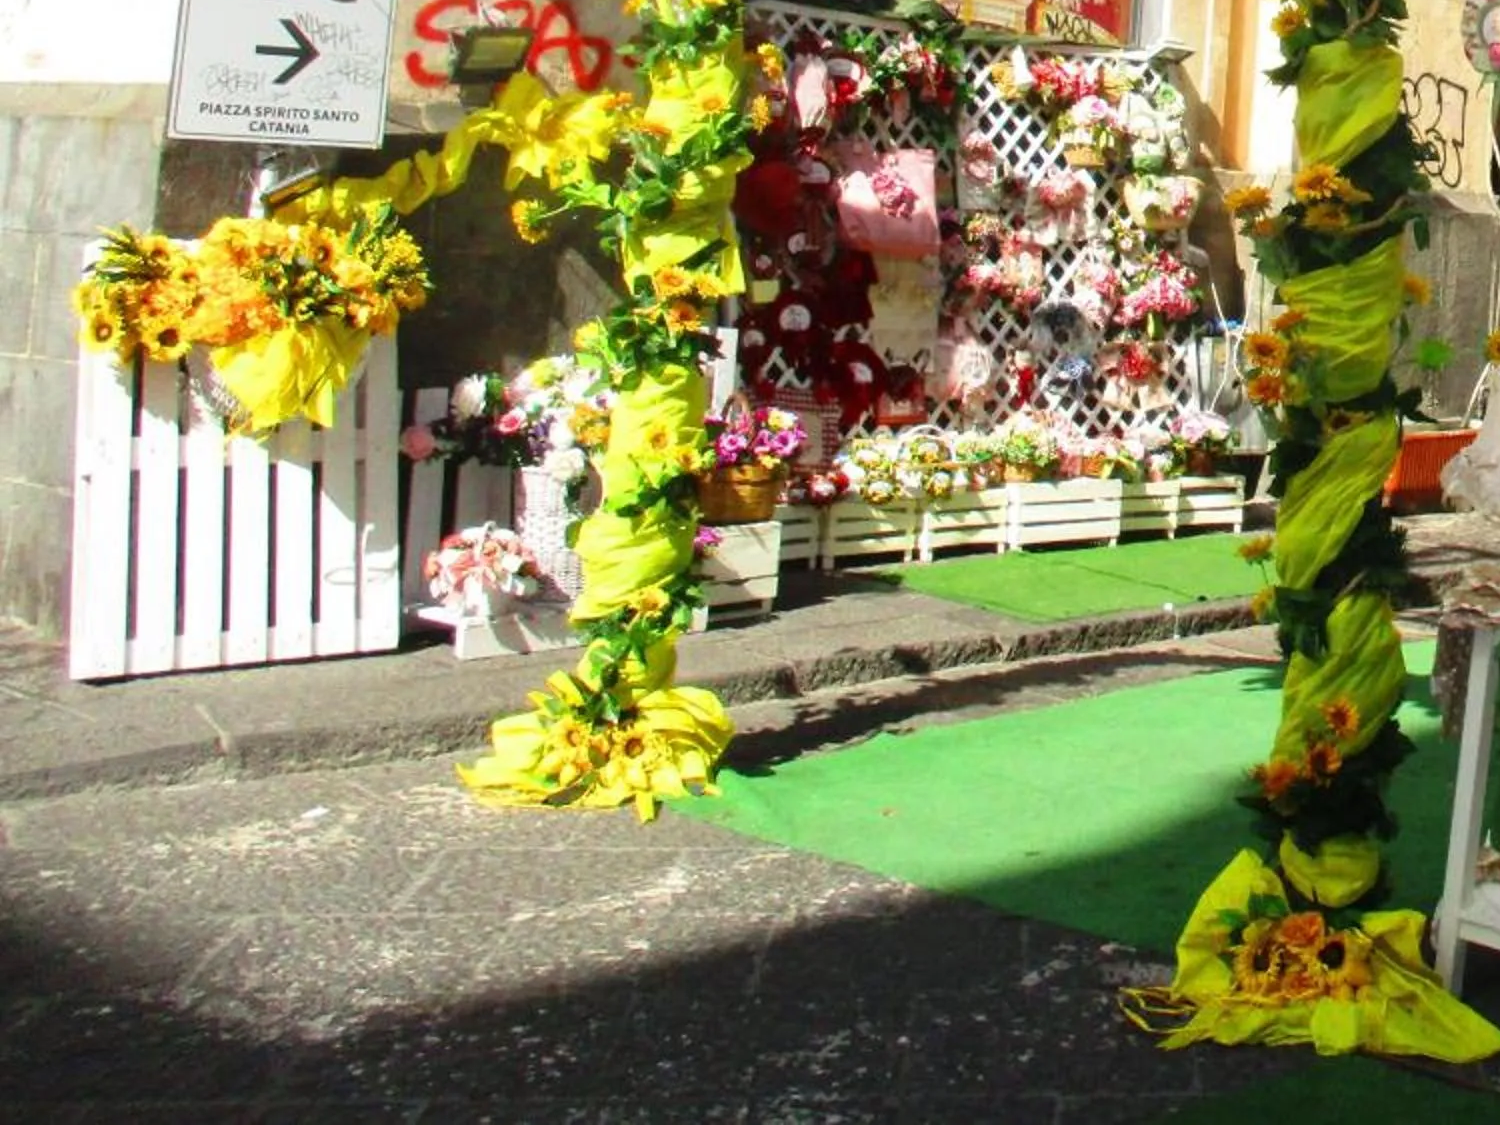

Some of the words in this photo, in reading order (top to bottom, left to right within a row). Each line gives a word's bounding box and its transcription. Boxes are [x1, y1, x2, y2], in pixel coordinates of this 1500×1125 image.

[199, 101, 251, 117] PIAZZA
[254, 105, 311, 121] SPIRITO
[313, 109, 360, 123] SANTO
[248, 120, 310, 135] CATANIA
